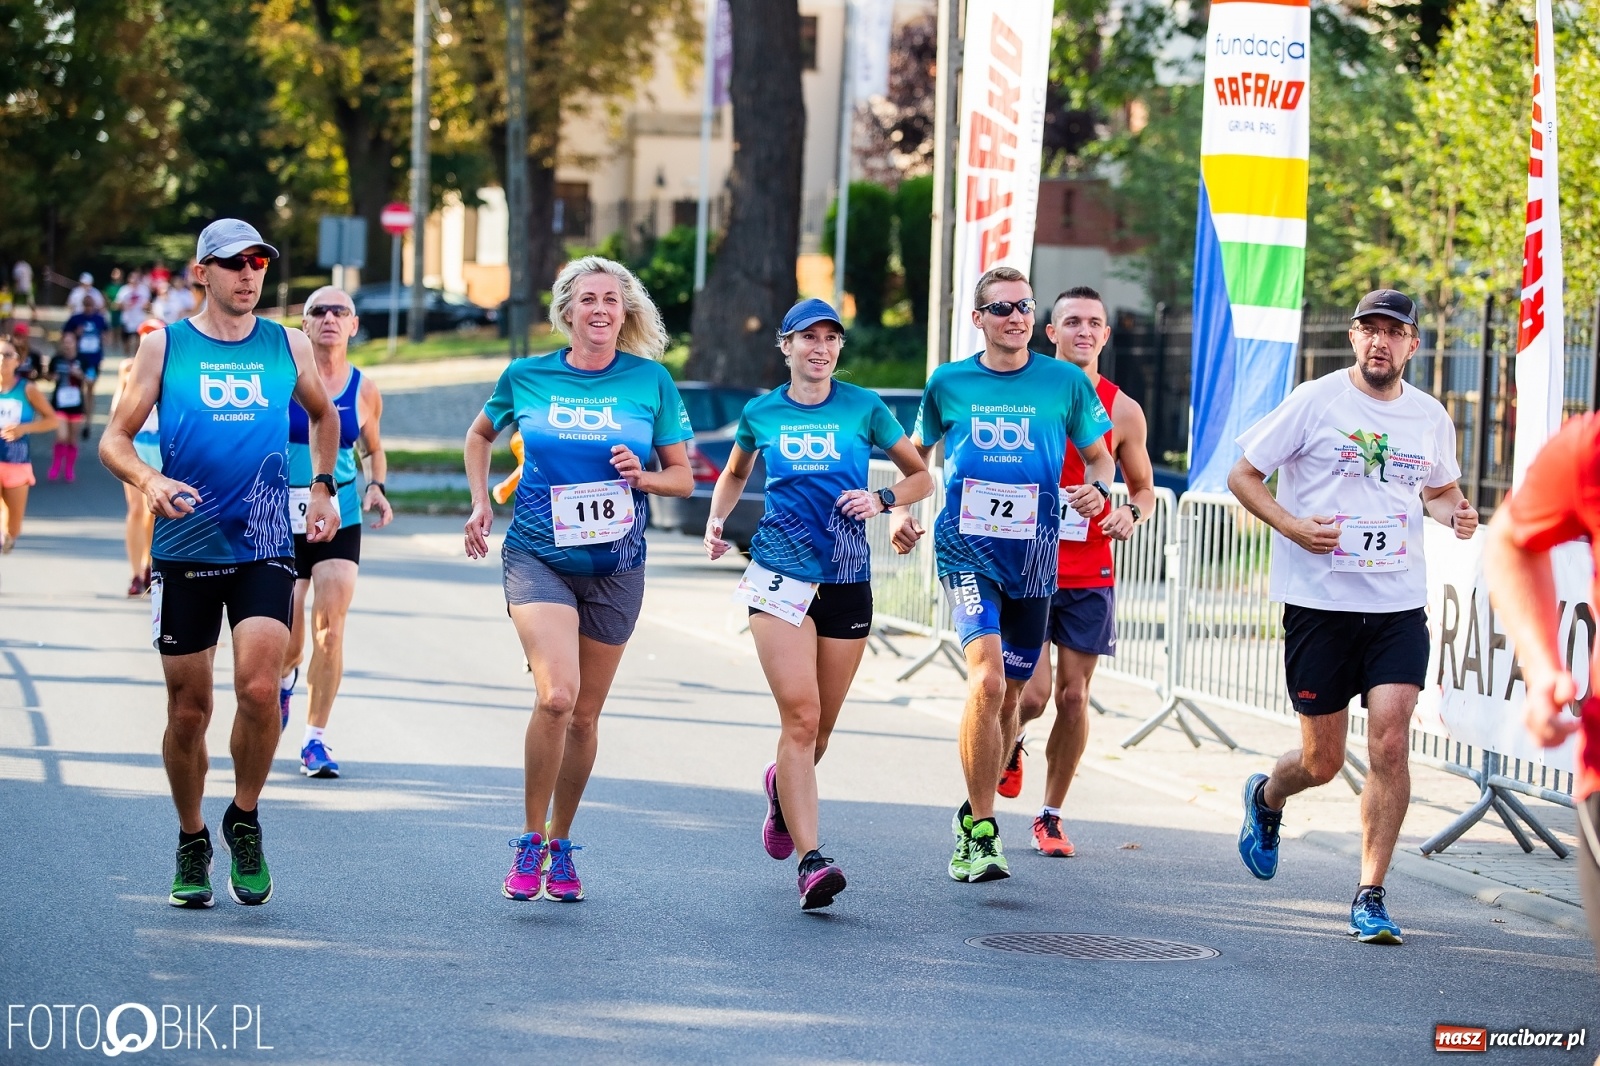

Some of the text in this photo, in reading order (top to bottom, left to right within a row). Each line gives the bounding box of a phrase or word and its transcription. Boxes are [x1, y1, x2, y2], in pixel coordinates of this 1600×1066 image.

[1215, 33, 1305, 64] fundacja
[1213, 71, 1305, 110] RAFAKO
[200, 374, 269, 409] bbl
[212, 412, 256, 422] RACIBÓRZ
[547, 402, 622, 431] bbl
[971, 404, 1036, 415] BiegamBoLubię
[558, 432, 607, 442] RACIBÓRZ
[971, 417, 1035, 451] bbl
[779, 431, 841, 461] bbl
[792, 463, 829, 471] RACIBÓRZ
[983, 454, 1023, 464] RACIBÓRZ
[576, 499, 615, 522] 118
[990, 498, 1014, 518] 72
[1363, 531, 1387, 551] 73
[768, 575, 784, 592] 3
